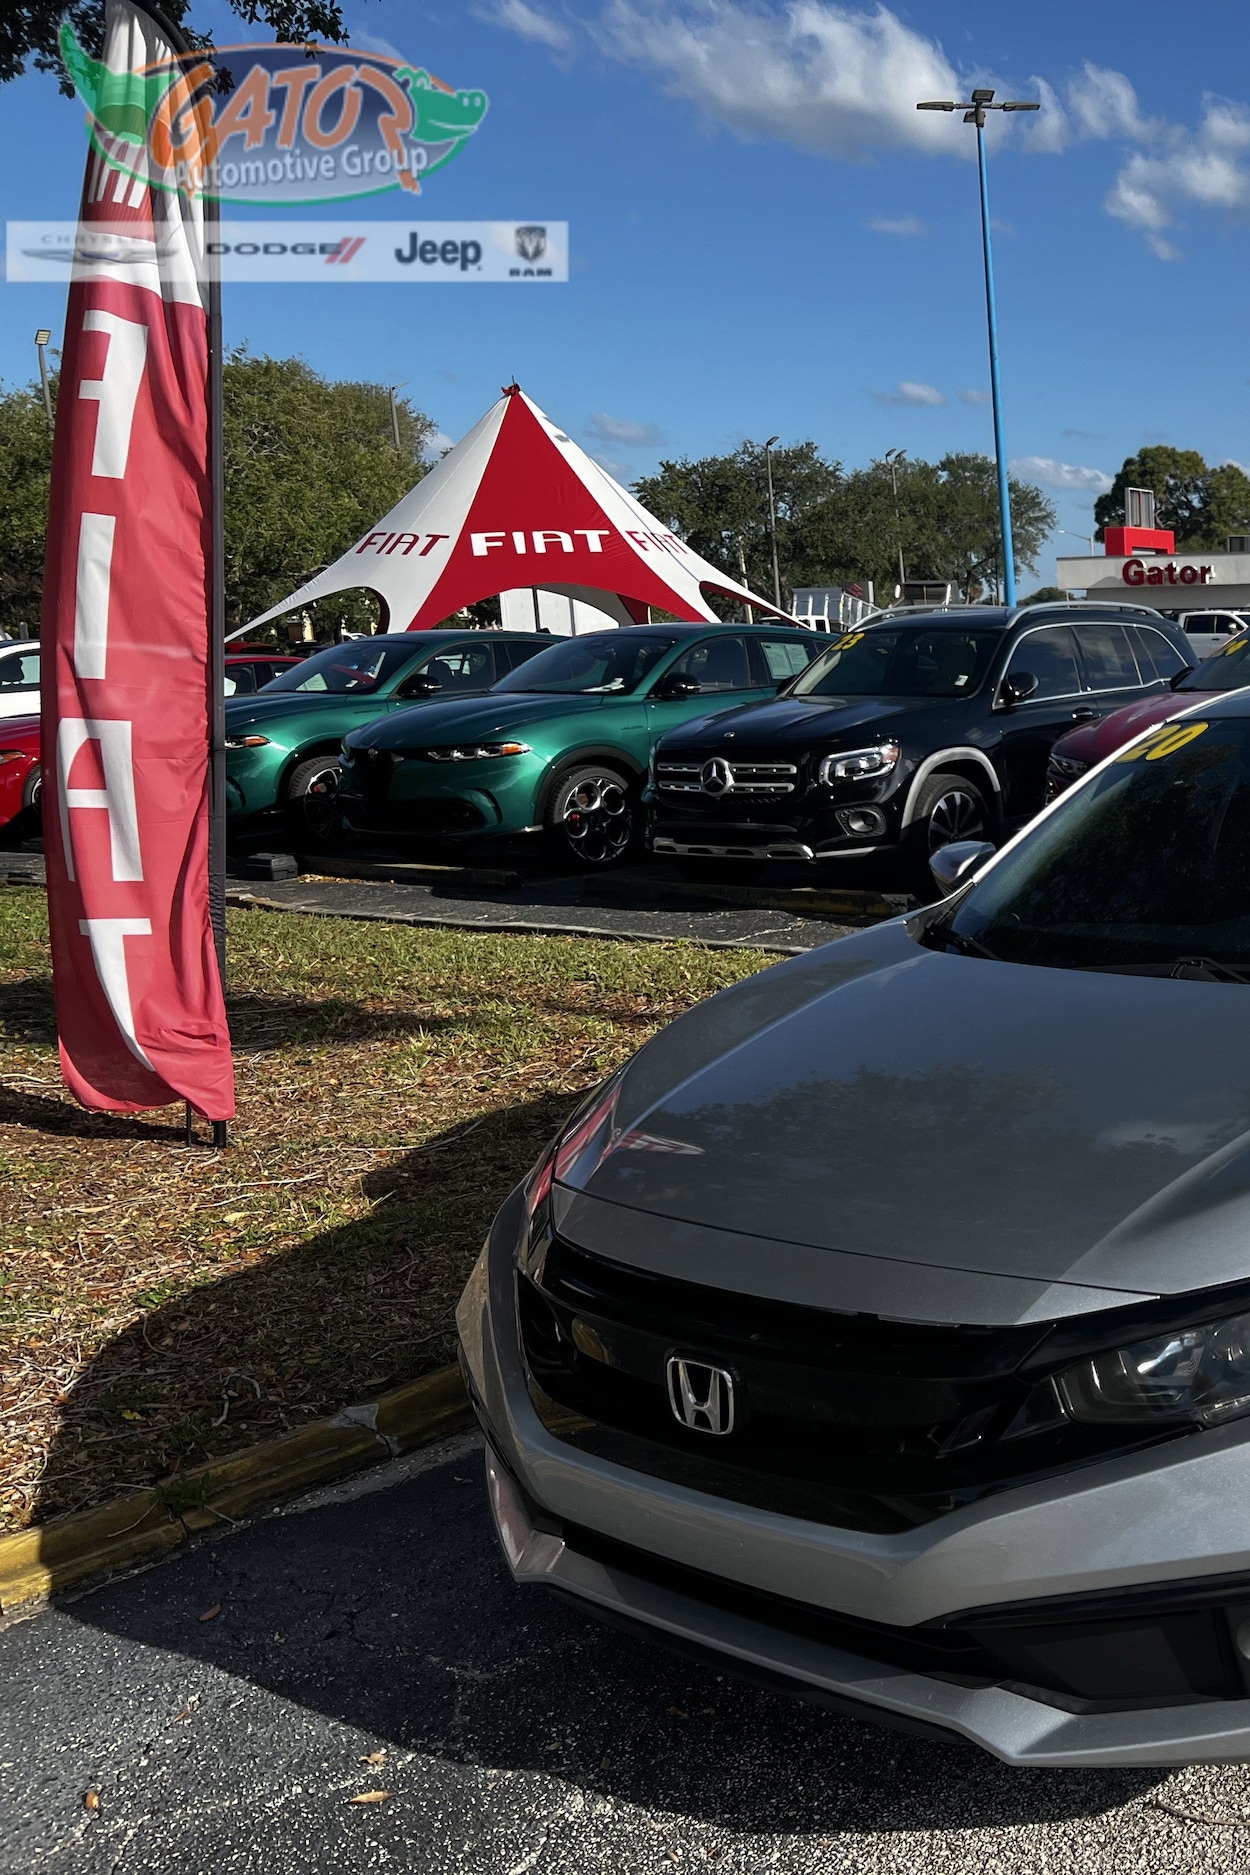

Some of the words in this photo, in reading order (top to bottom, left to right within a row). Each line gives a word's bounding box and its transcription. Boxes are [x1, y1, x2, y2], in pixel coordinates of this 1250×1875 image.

[355, 531, 451, 557] FIAT
[469, 528, 611, 557] FIAT
[624, 529, 689, 555] FIAT
[1122, 558, 1214, 586] Gator
[1115, 722, 1209, 763] 20
